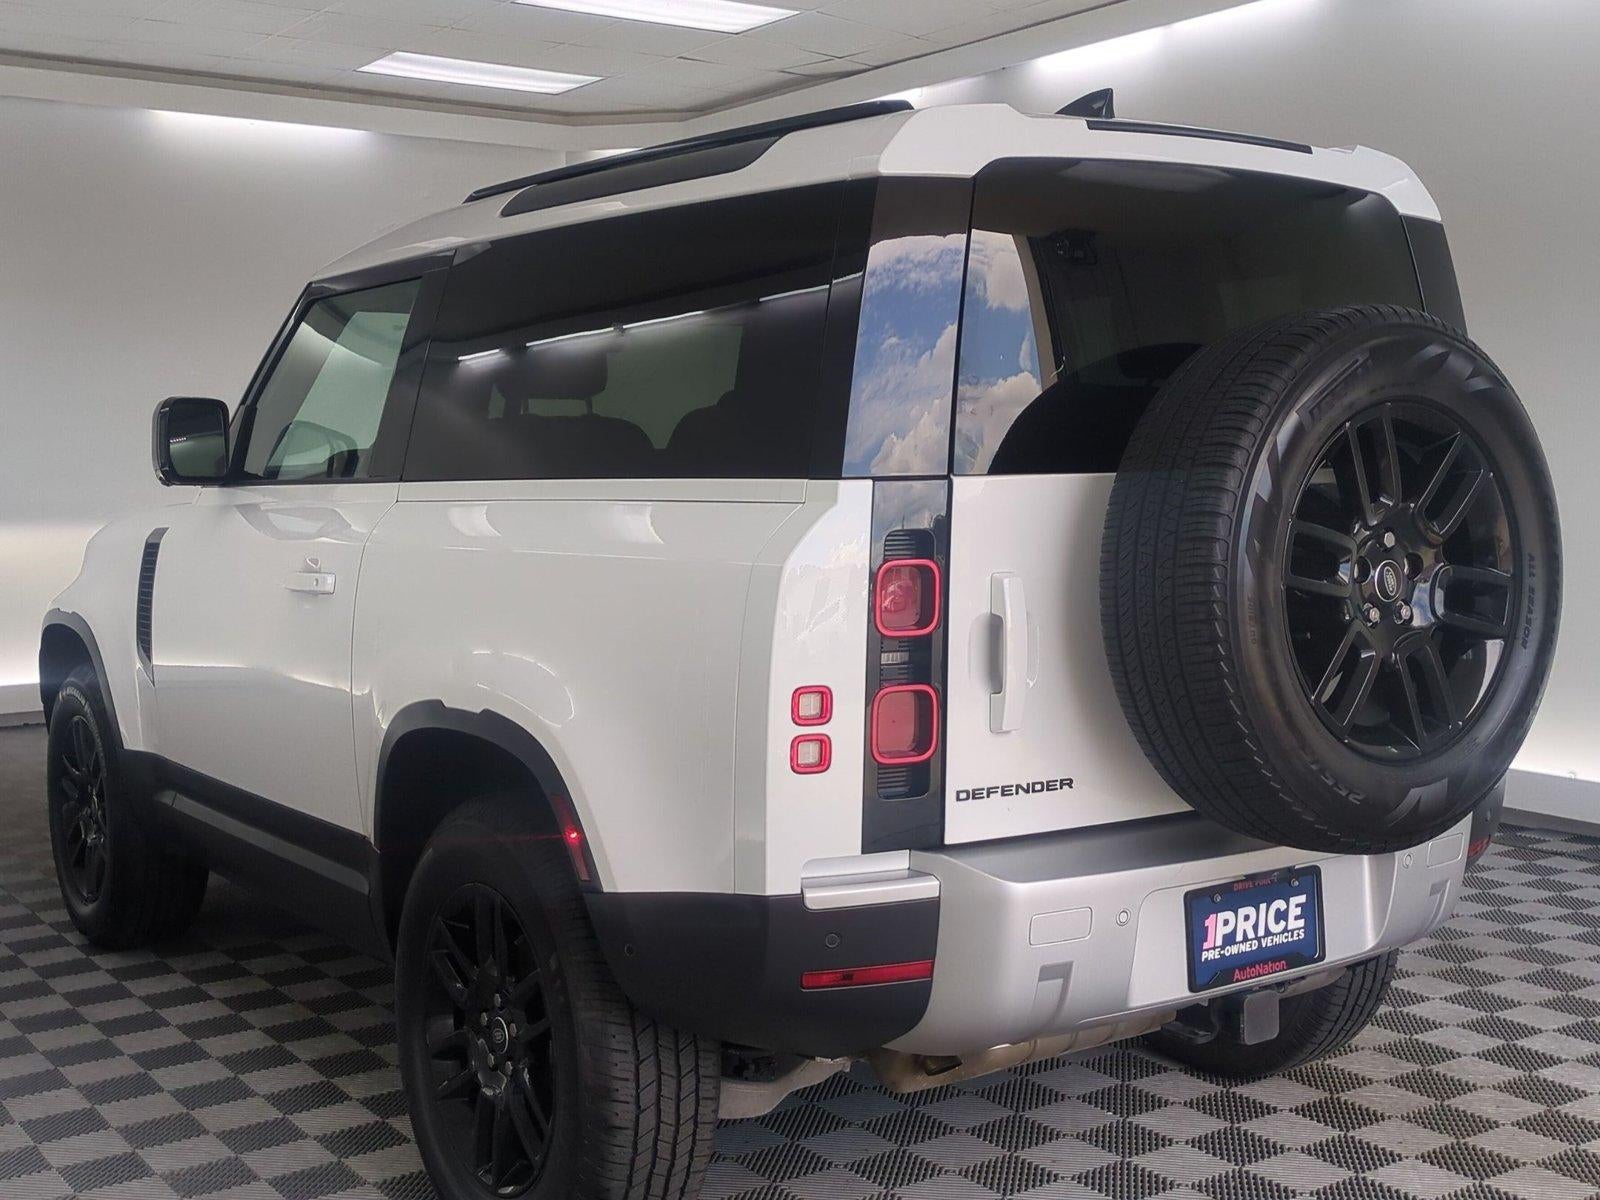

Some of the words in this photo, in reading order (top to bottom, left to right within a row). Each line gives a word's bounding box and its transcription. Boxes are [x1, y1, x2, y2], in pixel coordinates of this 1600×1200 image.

[956, 777, 1074, 802] DEFENDER
[1201, 940, 1259, 963] PRE-OWNED
[1261, 928, 1305, 948] VEHICLES
[1233, 959, 1287, 982] AutoNation
